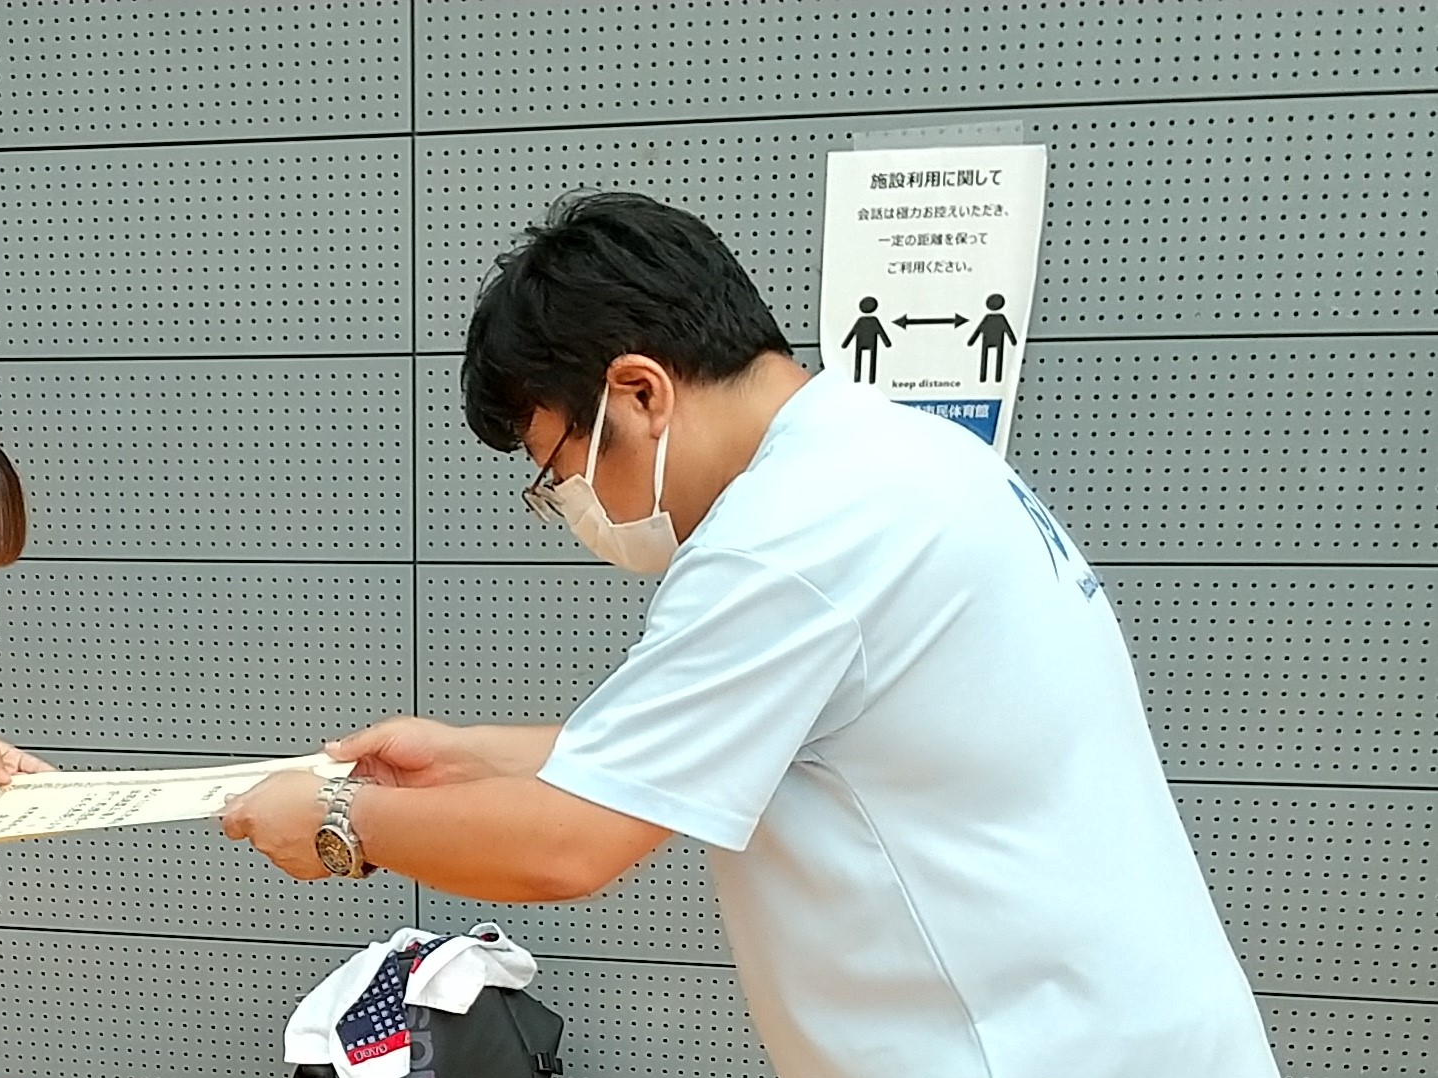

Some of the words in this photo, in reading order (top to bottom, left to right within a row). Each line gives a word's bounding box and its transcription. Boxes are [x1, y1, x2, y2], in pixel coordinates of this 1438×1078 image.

[870, 169, 1003, 190] 施設利用に関して
[857, 204, 1010, 221] 会話は極力お控えいただき、
[878, 232, 989, 247] 一定の距離を保って
[887, 260, 974, 275] ご利用ください。
[891, 379, 916, 390] keep
[918, 379, 962, 388] distance
